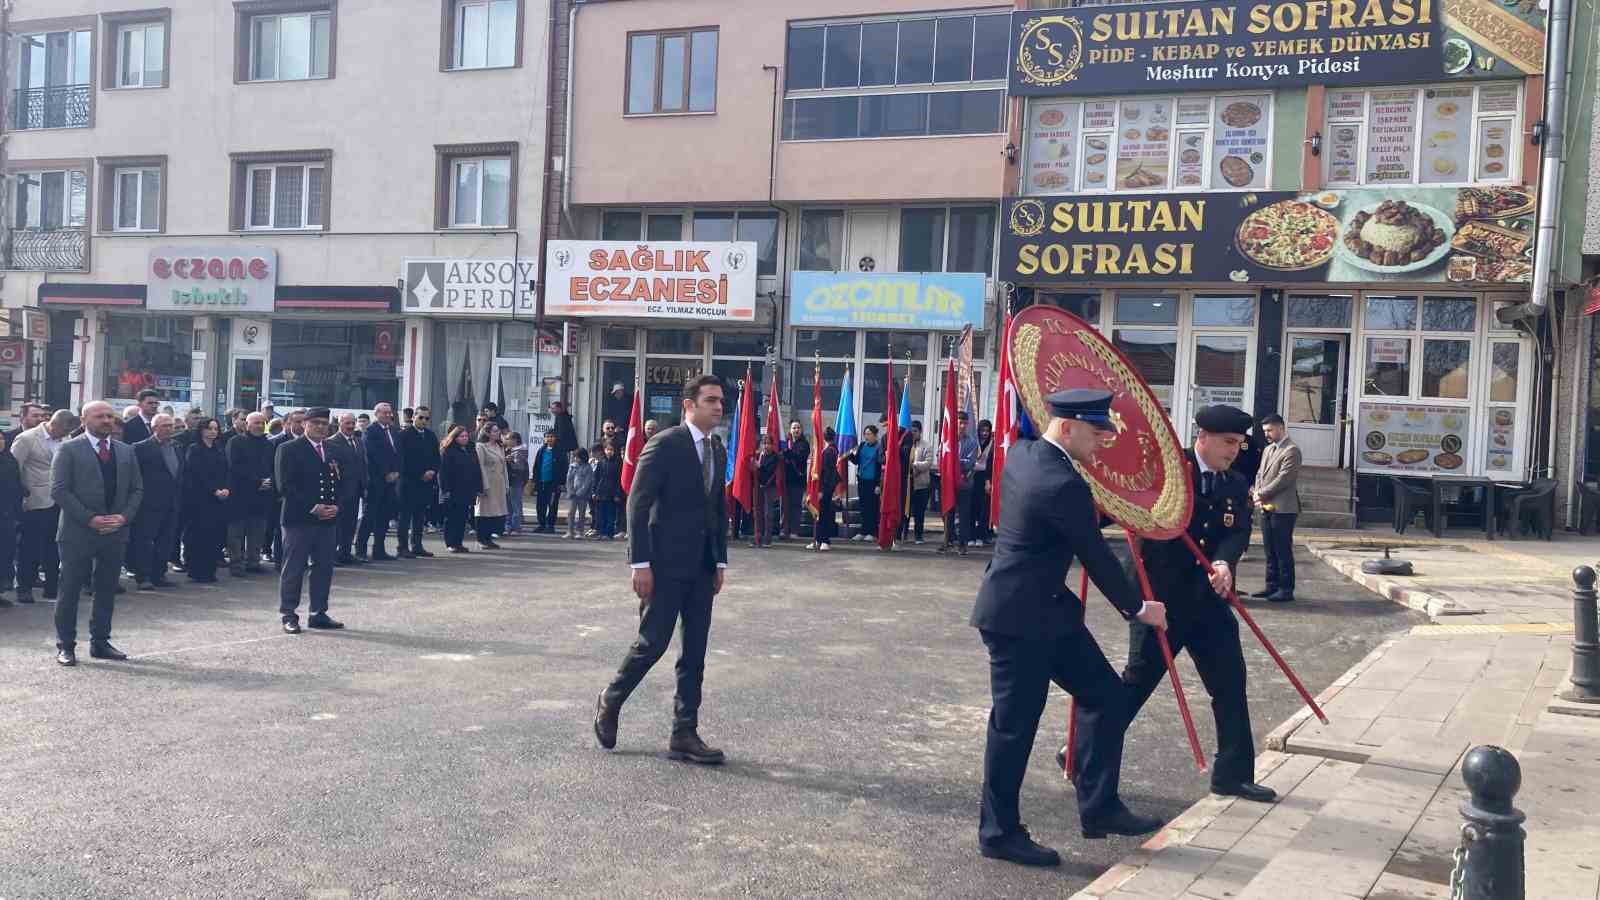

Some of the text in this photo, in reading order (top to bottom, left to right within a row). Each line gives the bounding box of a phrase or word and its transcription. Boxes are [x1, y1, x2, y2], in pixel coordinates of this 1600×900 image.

[1090, 0, 1432, 41] SULTAN SOFRASI
[1089, 44, 1134, 64] PİDE
[1152, 43, 1220, 62] KEBAP
[1225, 45, 1246, 59] ve
[1252, 38, 1325, 57] YEMEK
[1330, 32, 1430, 53] DÜNYASI
[1146, 56, 1361, 81] Meşhur Konya Pidesi
[1050, 200, 1206, 233] SULTAN
[153, 258, 269, 280] eczane
[446, 262, 534, 284] AKSOY
[588, 245, 711, 273] SAĞLIK
[1016, 243, 1194, 275] SOFRASI
[446, 289, 533, 309] PERDE
[569, 273, 728, 305] ECZANESİ
[666, 305, 694, 315] YILMAZ
